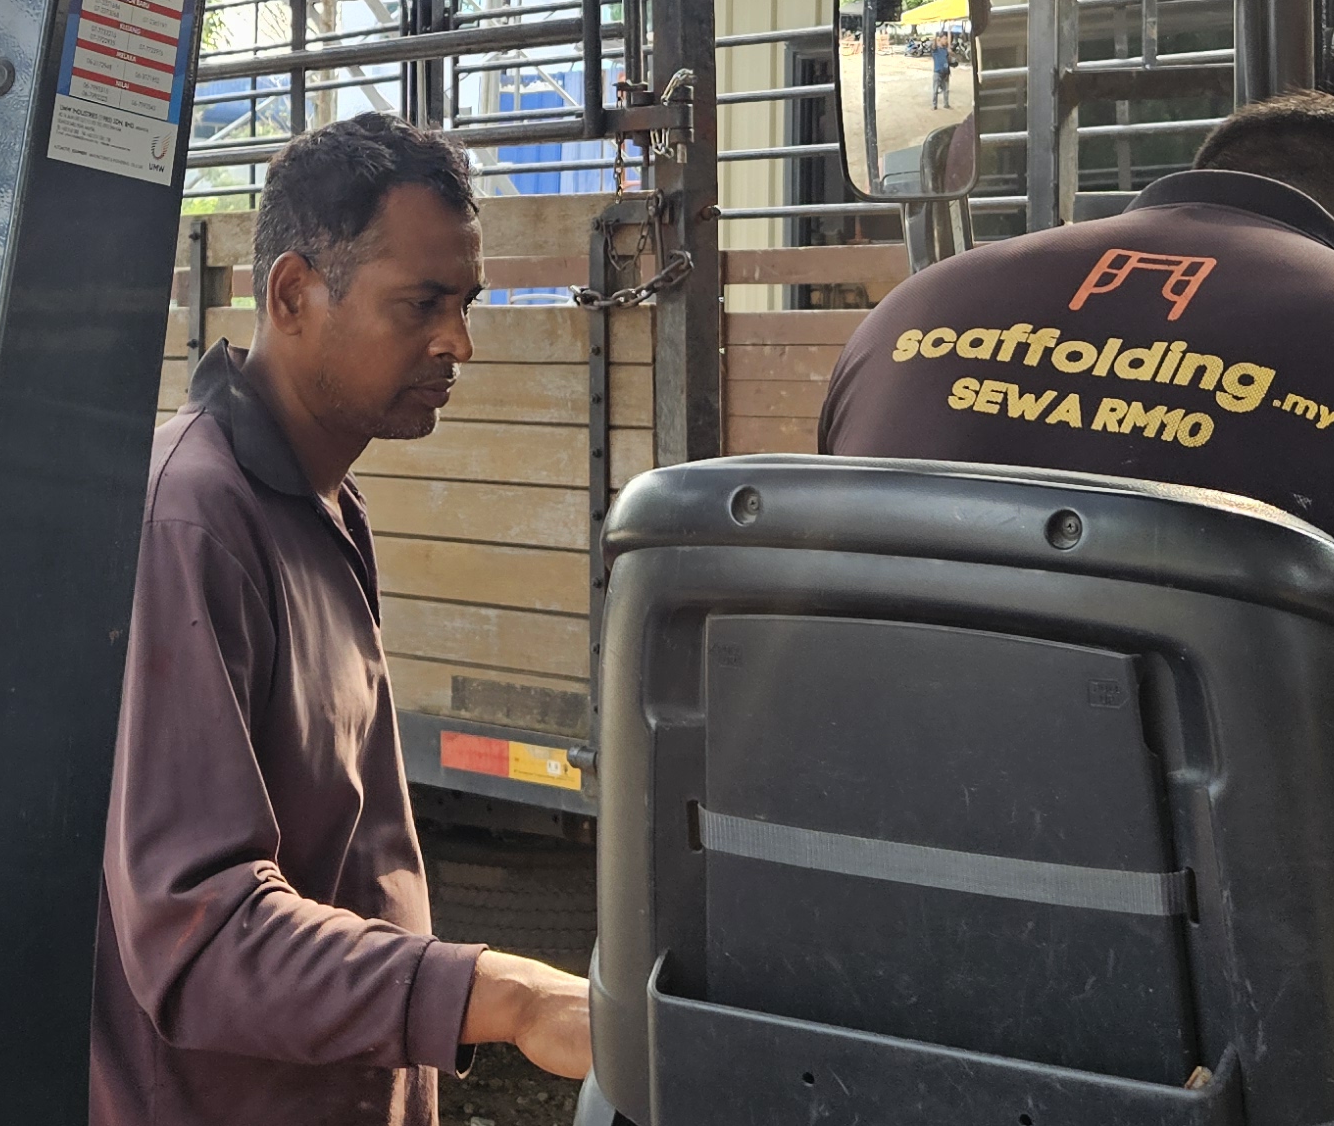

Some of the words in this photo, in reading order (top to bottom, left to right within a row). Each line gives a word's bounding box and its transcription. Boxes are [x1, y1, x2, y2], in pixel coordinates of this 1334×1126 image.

[148, 162, 165, 172] UMW
[948, 376, 1081, 429] SEWA
[1091, 397, 1215, 448] RM10
